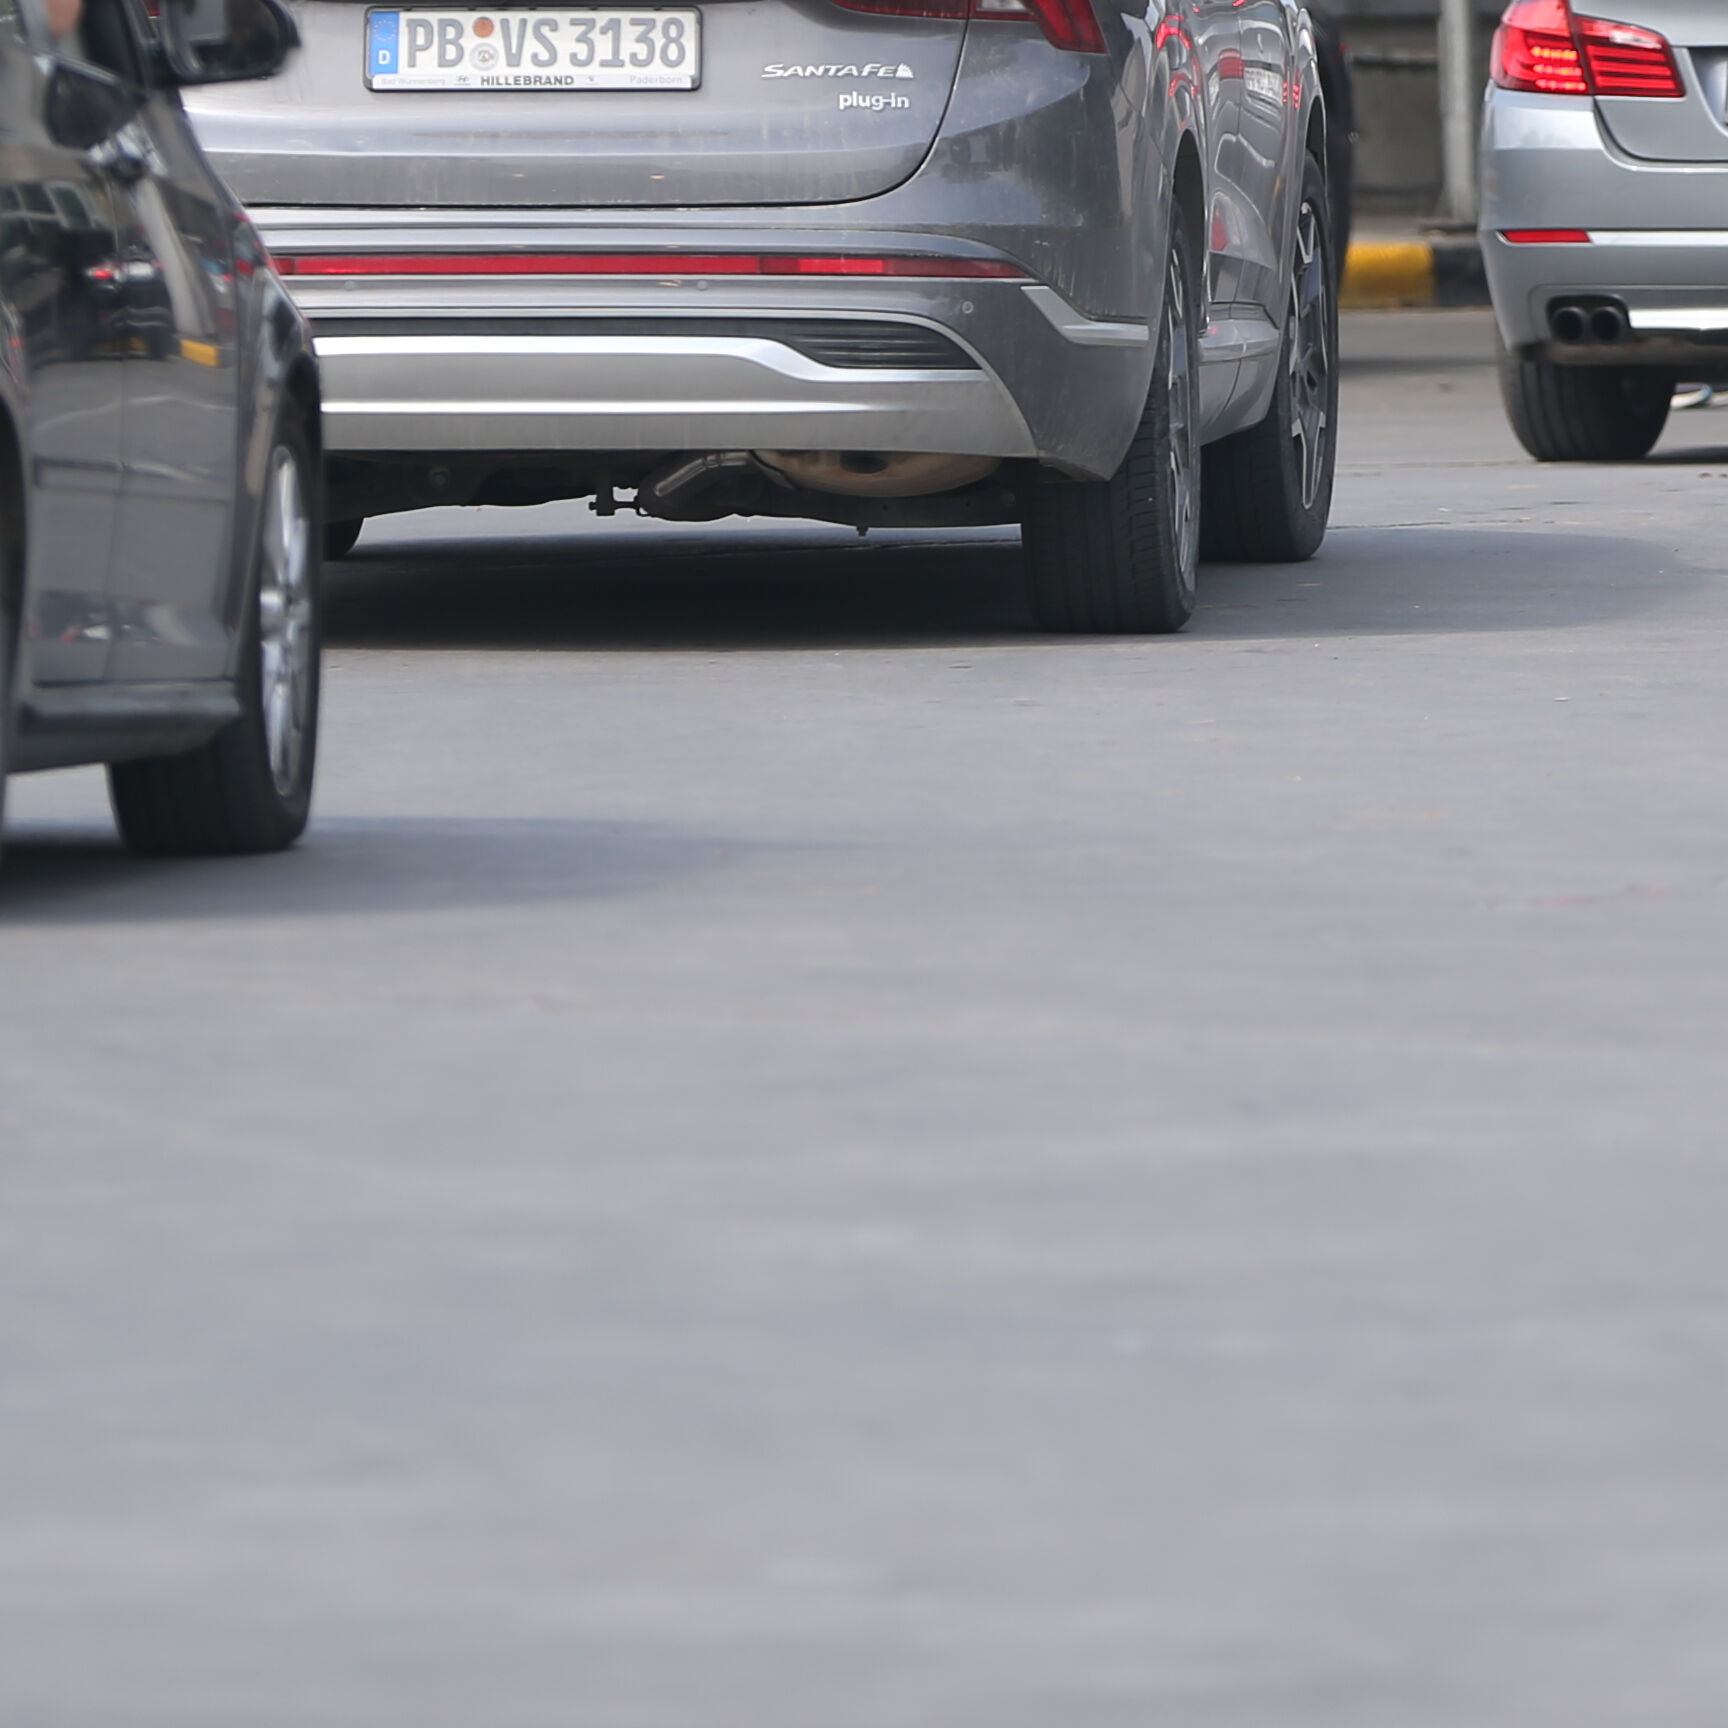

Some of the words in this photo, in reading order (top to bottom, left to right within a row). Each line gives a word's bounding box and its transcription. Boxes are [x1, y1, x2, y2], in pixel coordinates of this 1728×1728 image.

[406, 18, 465, 68] PB
[499, 18, 559, 68] VS
[569, 17, 686, 68] 3138
[378, 50, 391, 64] D
[480, 75, 574, 86] HILLEBRAND
[839, 91, 909, 110] plug-in
